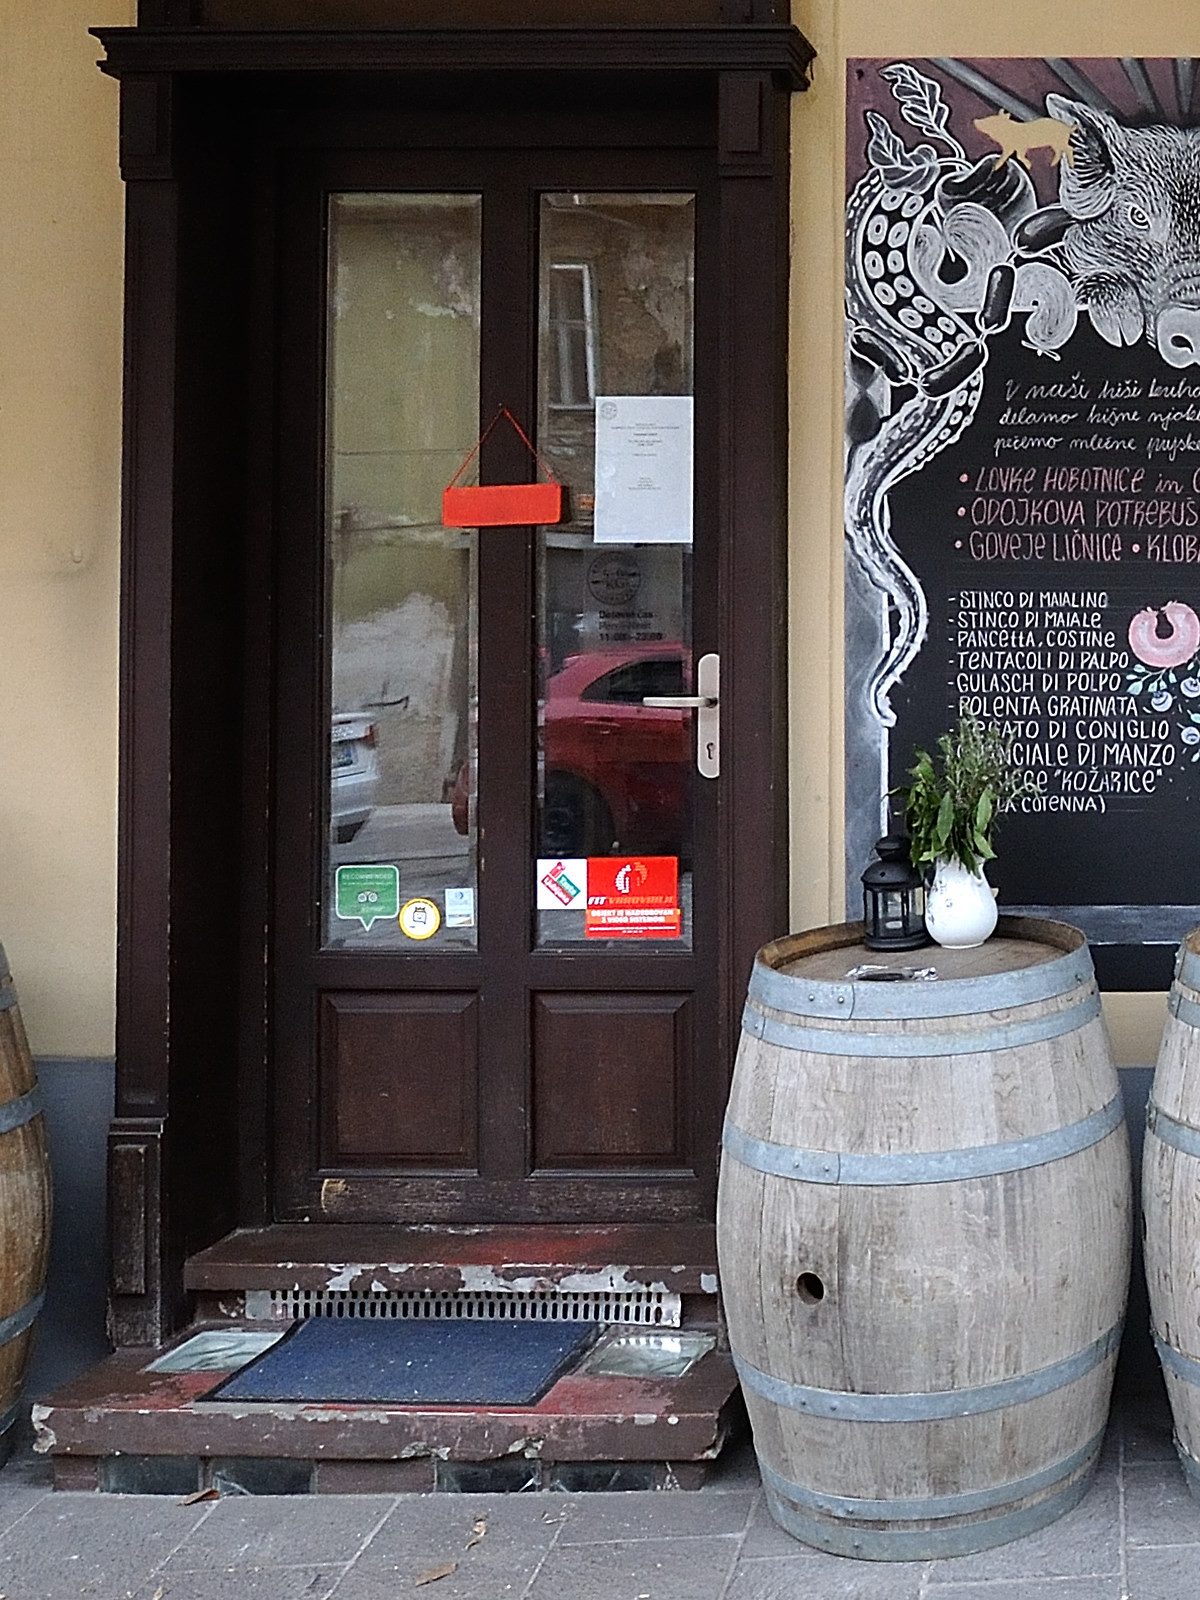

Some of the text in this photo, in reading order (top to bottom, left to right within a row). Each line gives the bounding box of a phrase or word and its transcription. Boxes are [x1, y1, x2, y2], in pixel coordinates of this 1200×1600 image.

[1025, 373, 1089, 399] naši
[999, 408, 1078, 424] delamo
[1156, 474, 1183, 493] in
[972, 498, 1084, 525] ODOJKOVA
[960, 591, 1108, 609] STINCO DI MAIALINO
[958, 611, 1019, 629] STINCO
[1025, 611, 1038, 627] DI
[1059, 651, 1074, 669] DI
[1081, 652, 1128, 669] PALPO
[957, 673, 1121, 693] GULASCH DI POLPO
[1048, 694, 1139, 717] GRATINATA
[1049, 721, 1066, 739] DI
[1076, 719, 1169, 741] CONIGLIO
[1078, 743, 1098, 769] DI
[1103, 743, 1175, 767] MANZO
